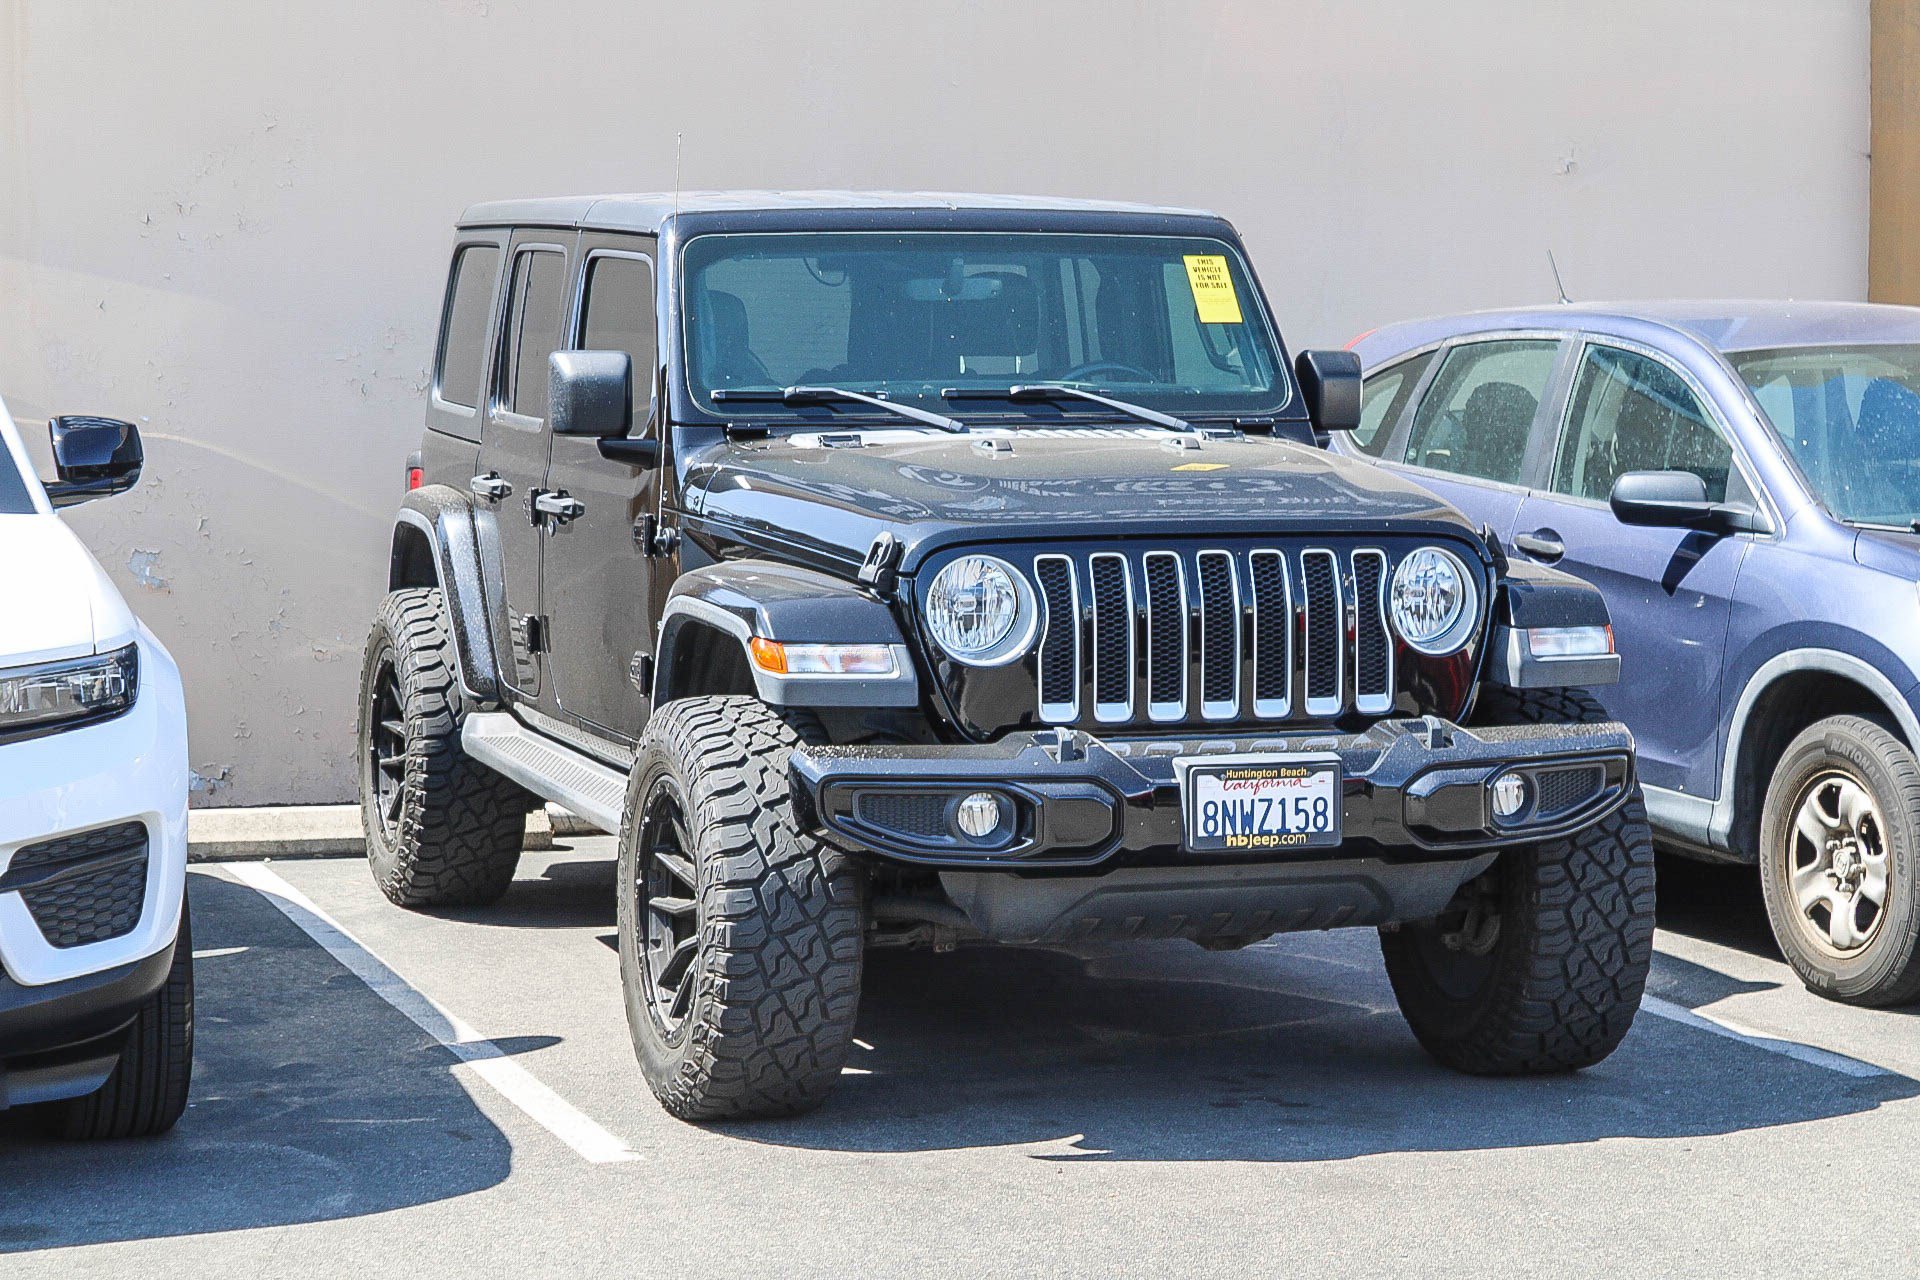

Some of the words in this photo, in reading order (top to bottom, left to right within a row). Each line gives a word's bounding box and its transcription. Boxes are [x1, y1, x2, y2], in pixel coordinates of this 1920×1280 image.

[1226, 768, 1278, 781] Huntington
[1280, 766, 1308, 778] Beach
[1222, 777, 1312, 796] California
[1202, 796, 1329, 836] 8NWZ158
